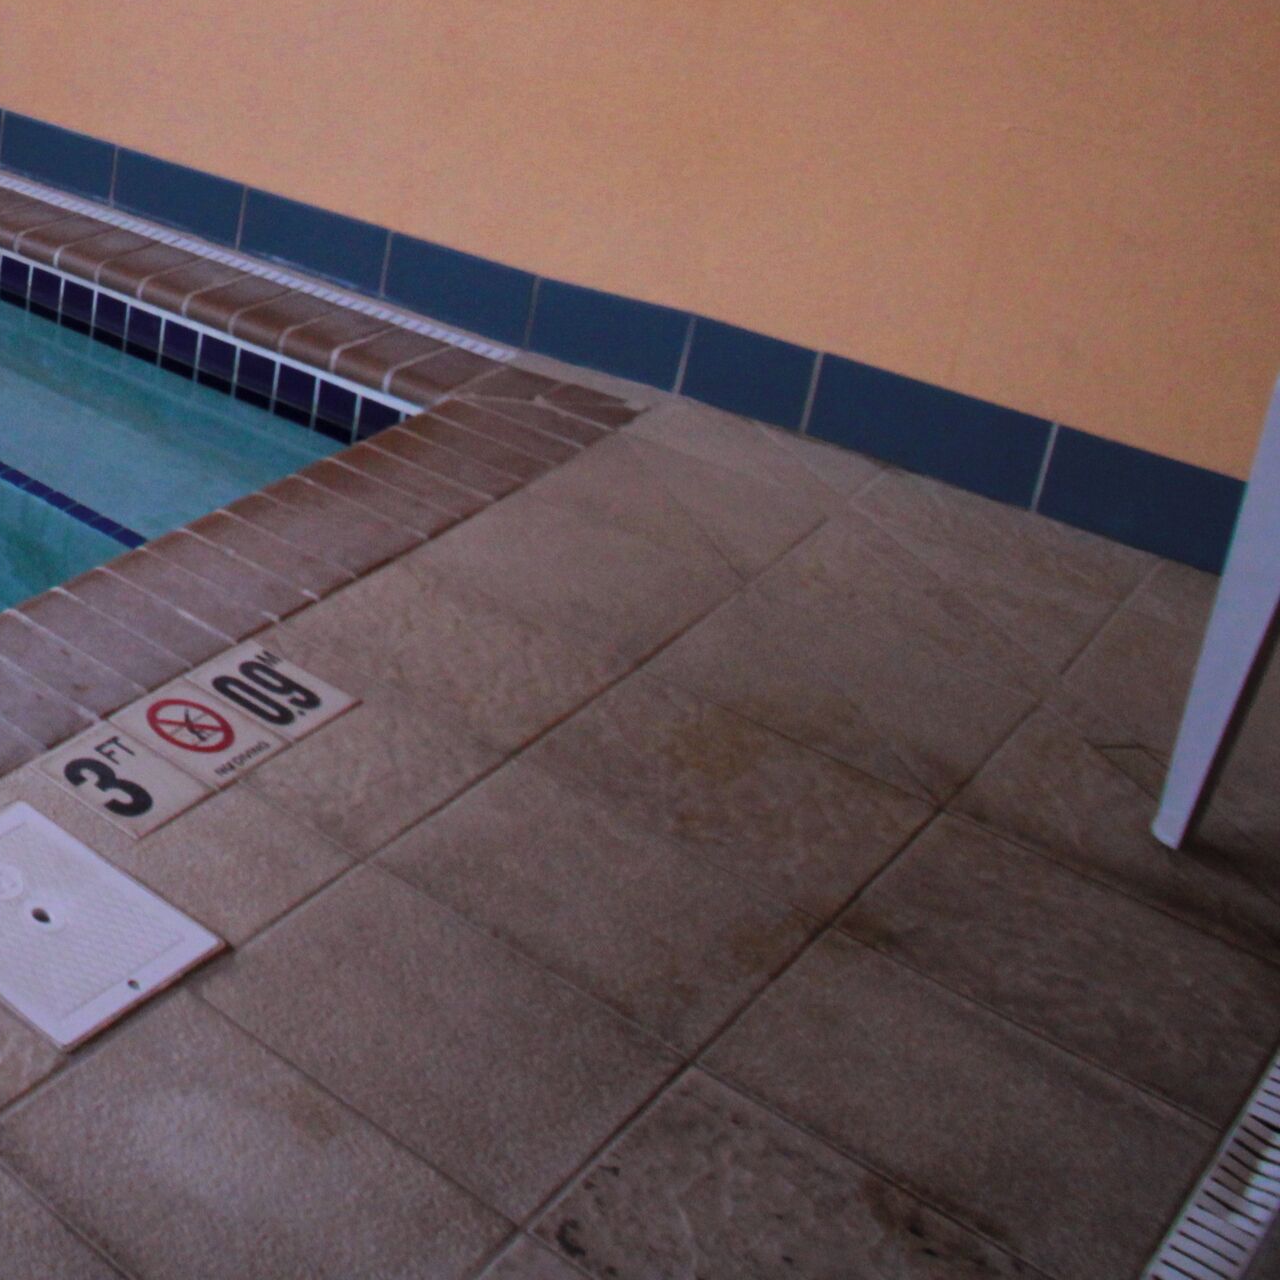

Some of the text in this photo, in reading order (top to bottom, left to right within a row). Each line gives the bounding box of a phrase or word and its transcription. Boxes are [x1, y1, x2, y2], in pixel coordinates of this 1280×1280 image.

[63, 736, 153, 817] 3 FT
[232, 741, 271, 766] DIVING
